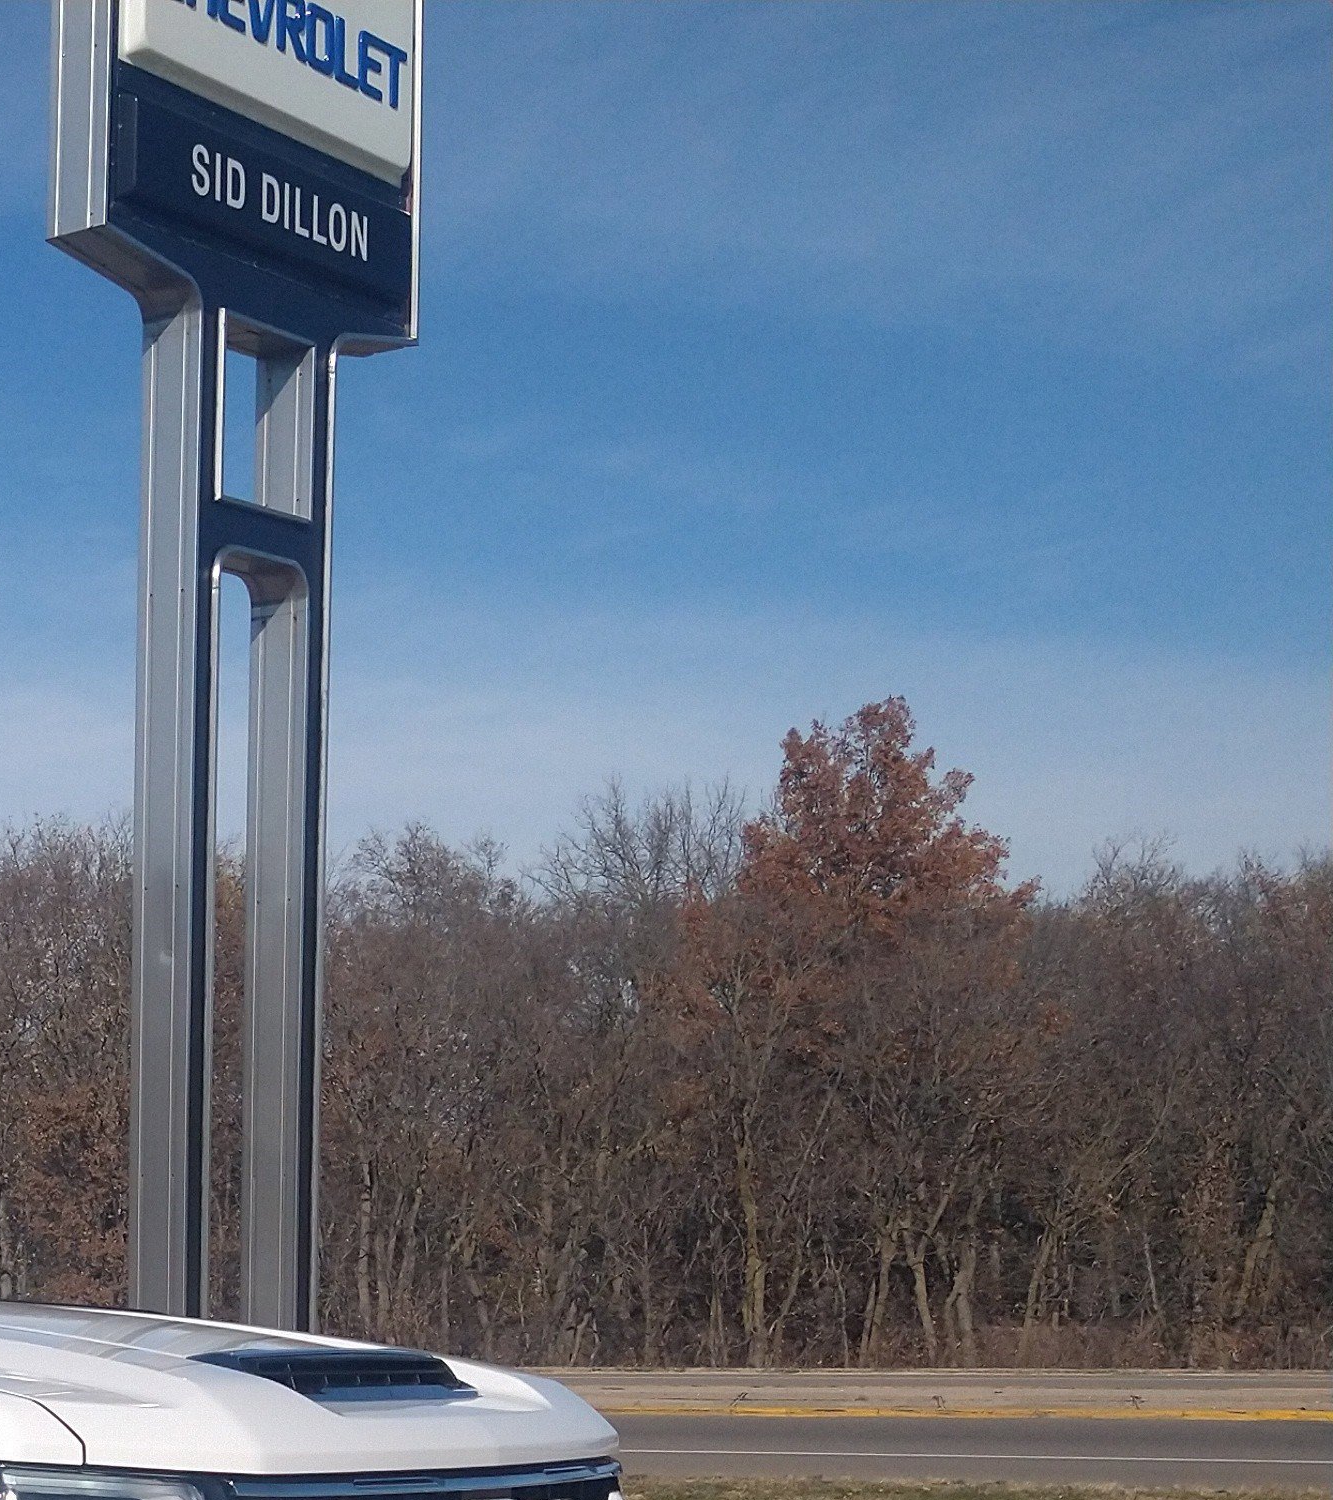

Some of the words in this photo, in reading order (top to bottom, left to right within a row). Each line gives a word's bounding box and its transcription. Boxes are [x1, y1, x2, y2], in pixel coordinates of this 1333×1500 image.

[170, 0, 407, 110] VROLET
[190, 143, 246, 210] SID
[261, 172, 369, 262] DILLON
